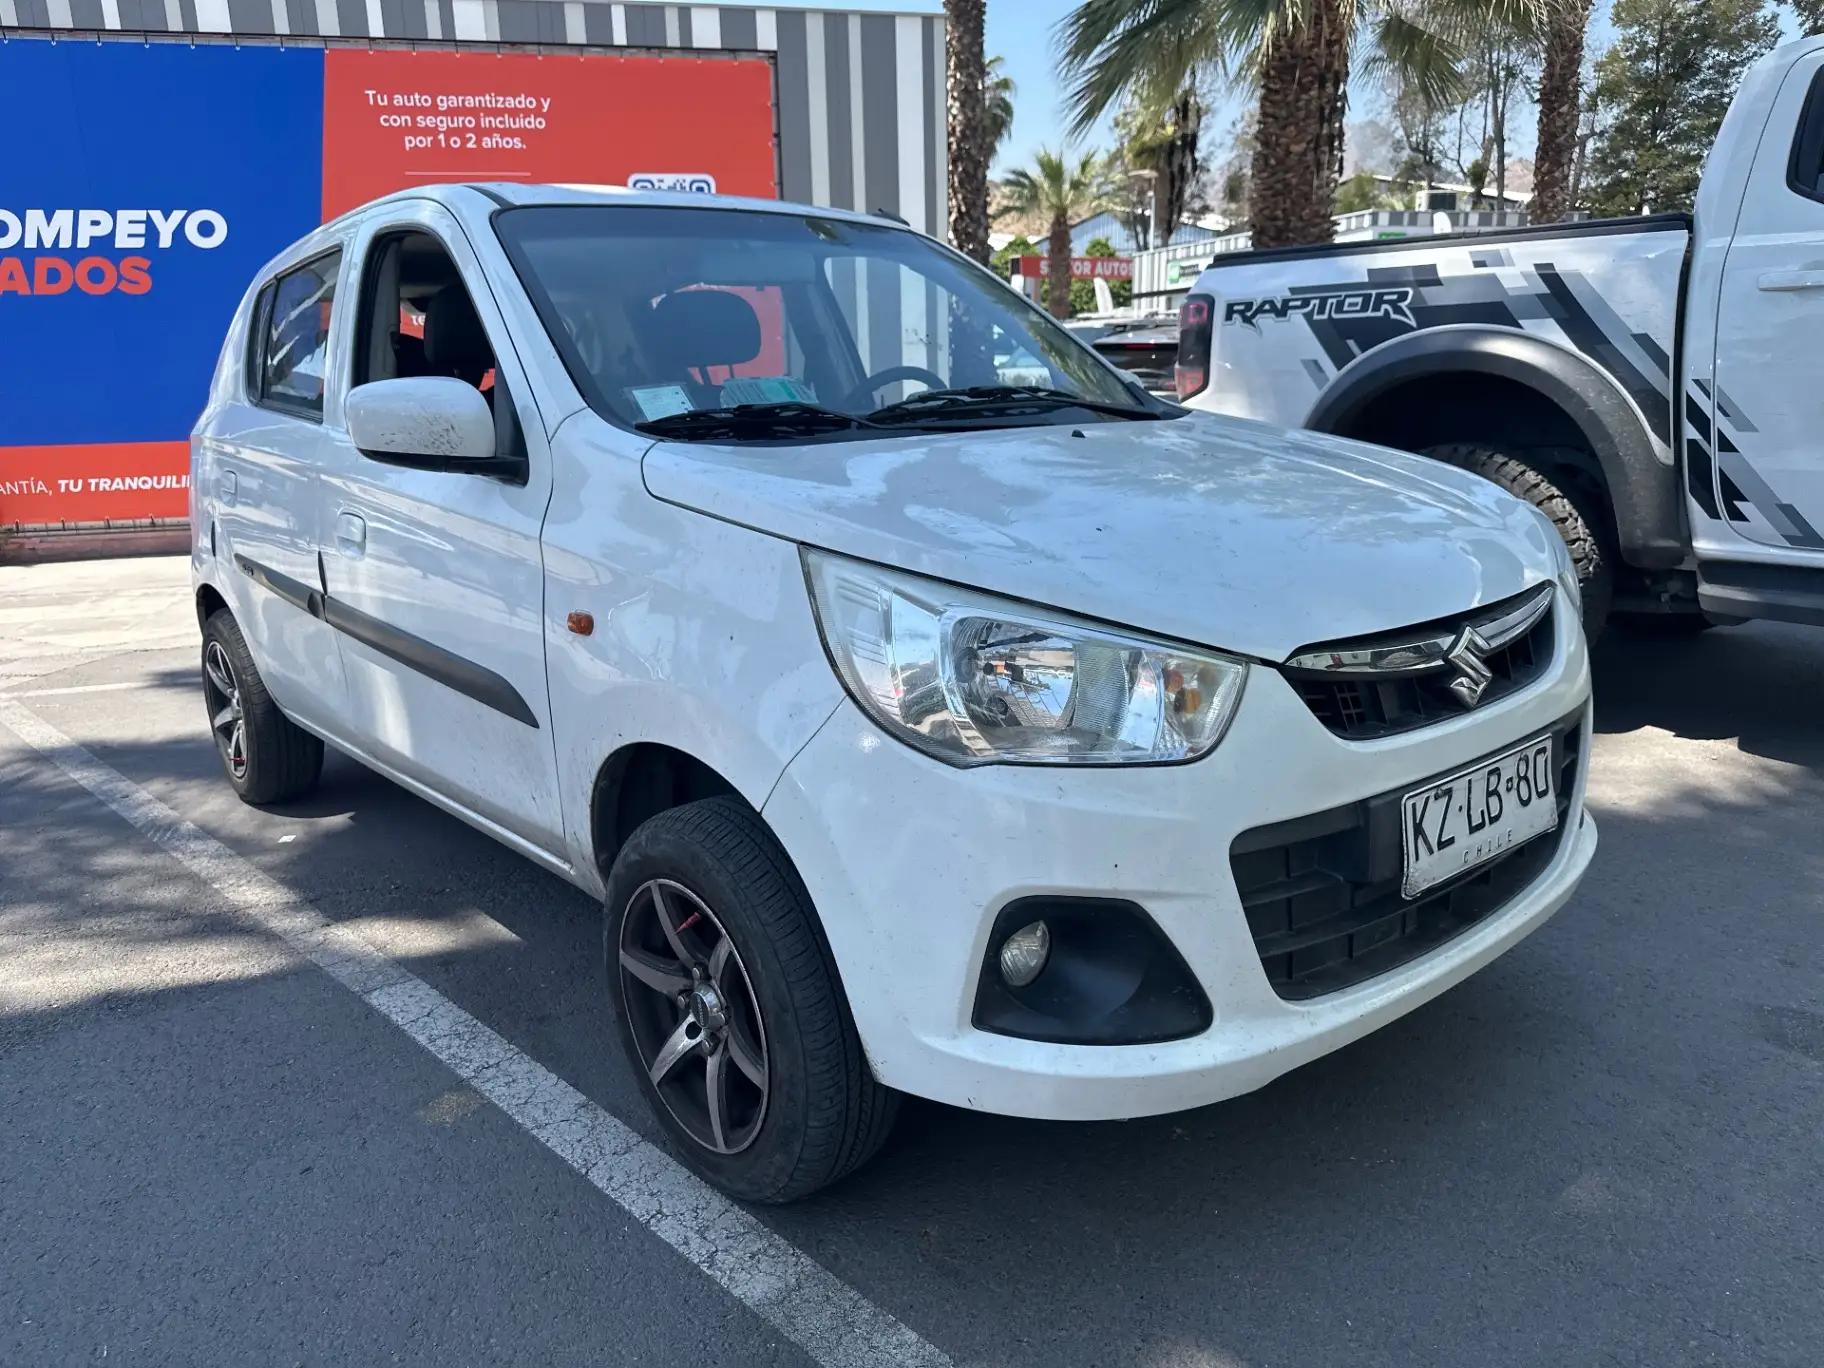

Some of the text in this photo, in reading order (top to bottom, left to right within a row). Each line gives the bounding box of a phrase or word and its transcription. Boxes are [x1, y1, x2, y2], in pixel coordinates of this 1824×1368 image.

[365, 90, 551, 112] Tu auto garantizado y
[380, 113, 546, 131] con seguro incluido
[404, 133, 527, 151] por 1 o 2 años.
[1224, 288, 1417, 332] RAPTOR
[58, 479, 83, 493] TU
[88, 475, 190, 491] TRANQUILI
[1463, 829, 1513, 864] CHILE
